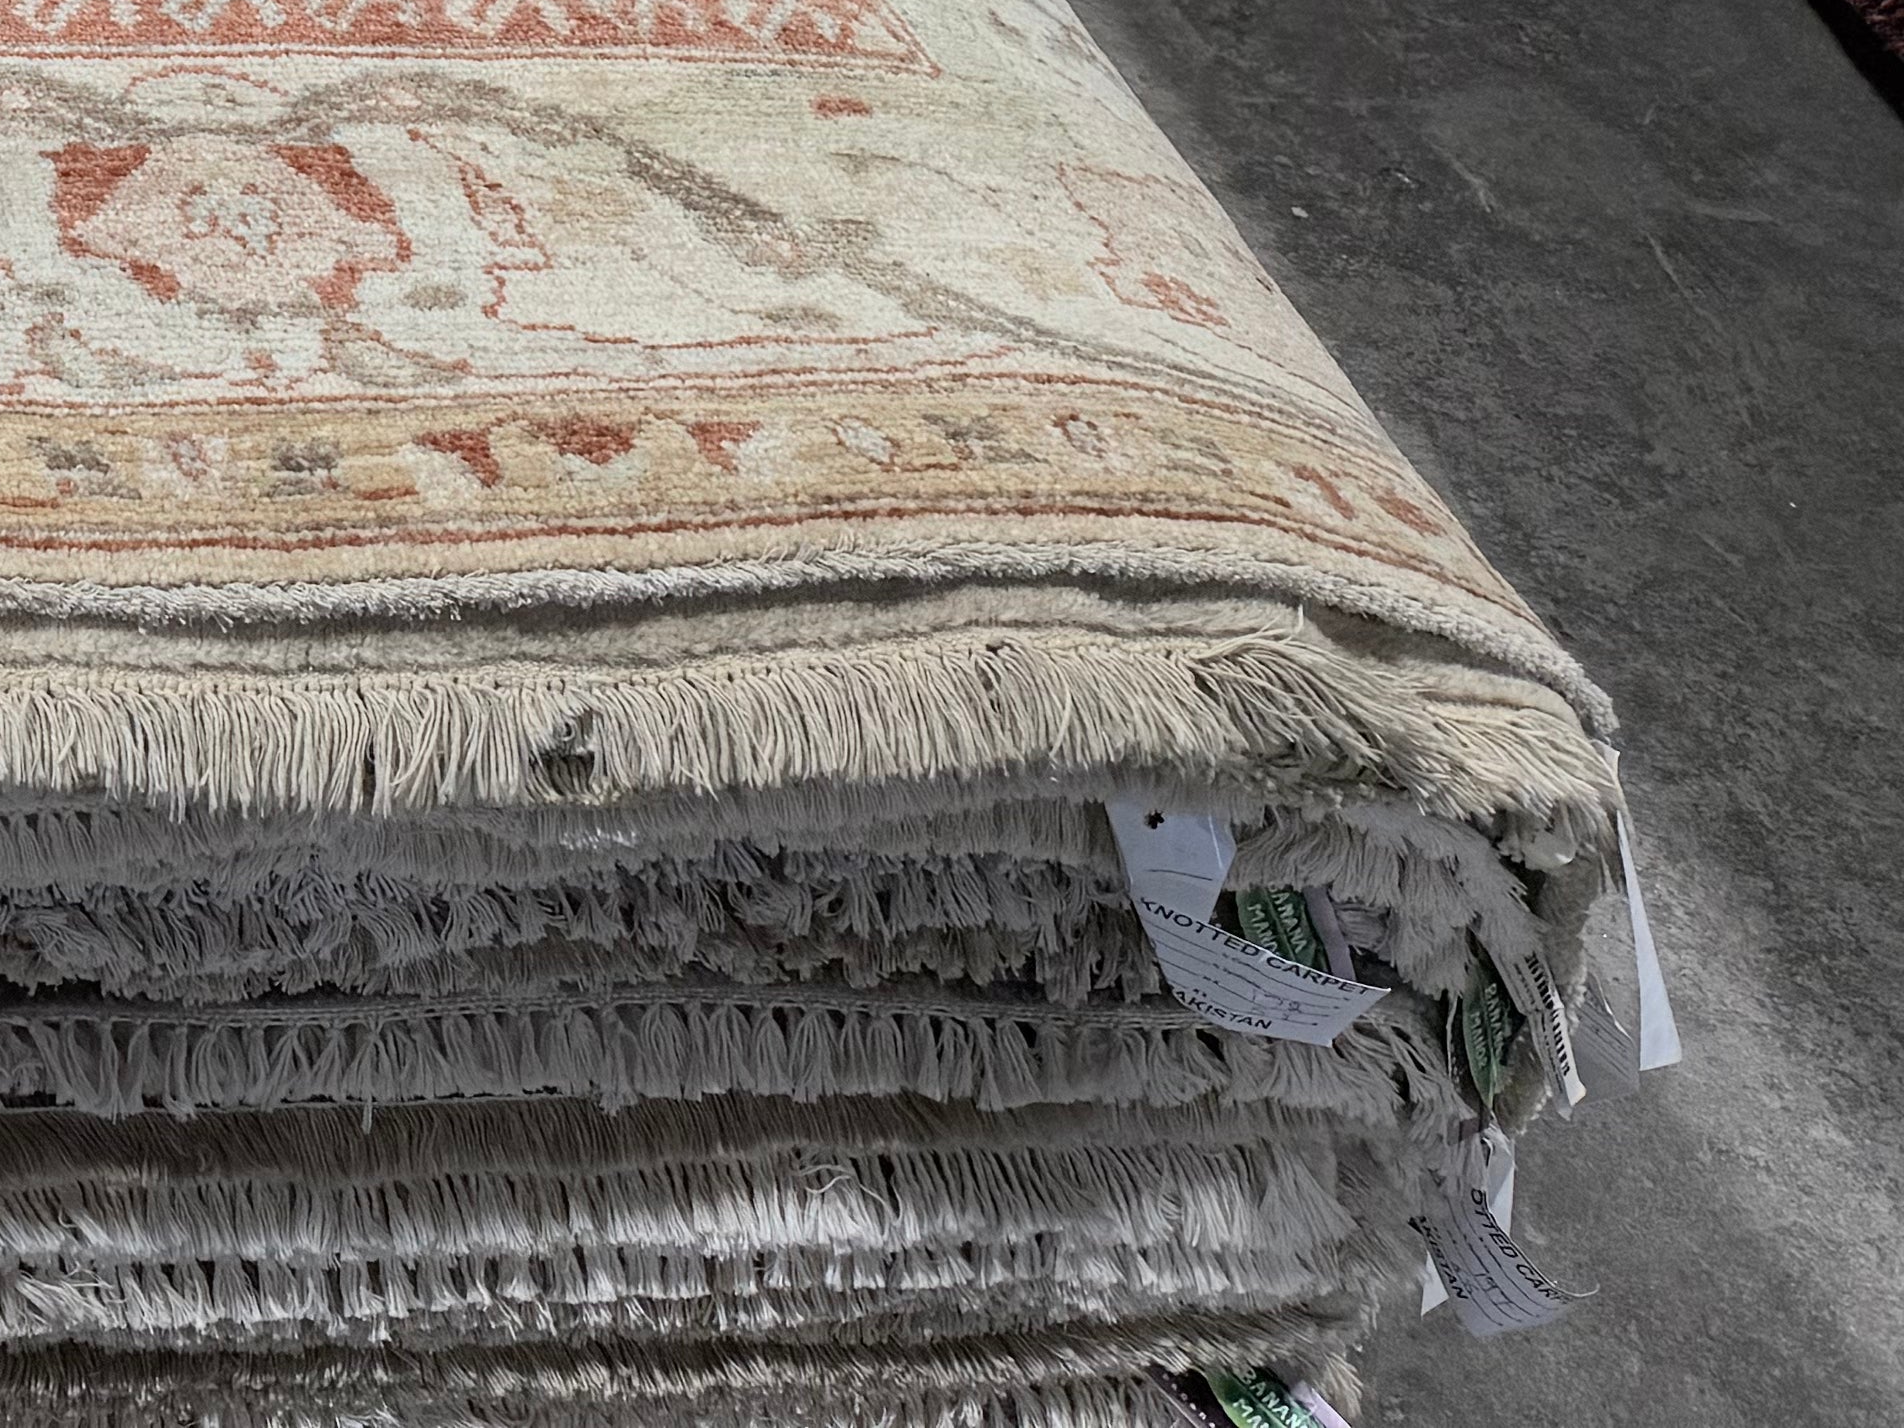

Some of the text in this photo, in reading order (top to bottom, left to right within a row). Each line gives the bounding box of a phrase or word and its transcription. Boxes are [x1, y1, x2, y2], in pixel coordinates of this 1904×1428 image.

[1140, 896, 1372, 996] KNOTTED CARPET
[1175, 989, 1272, 1030] AKISTAN
[1471, 1187, 1519, 1259] OTTED
[1232, 1365, 1309, 1428] BANAN
